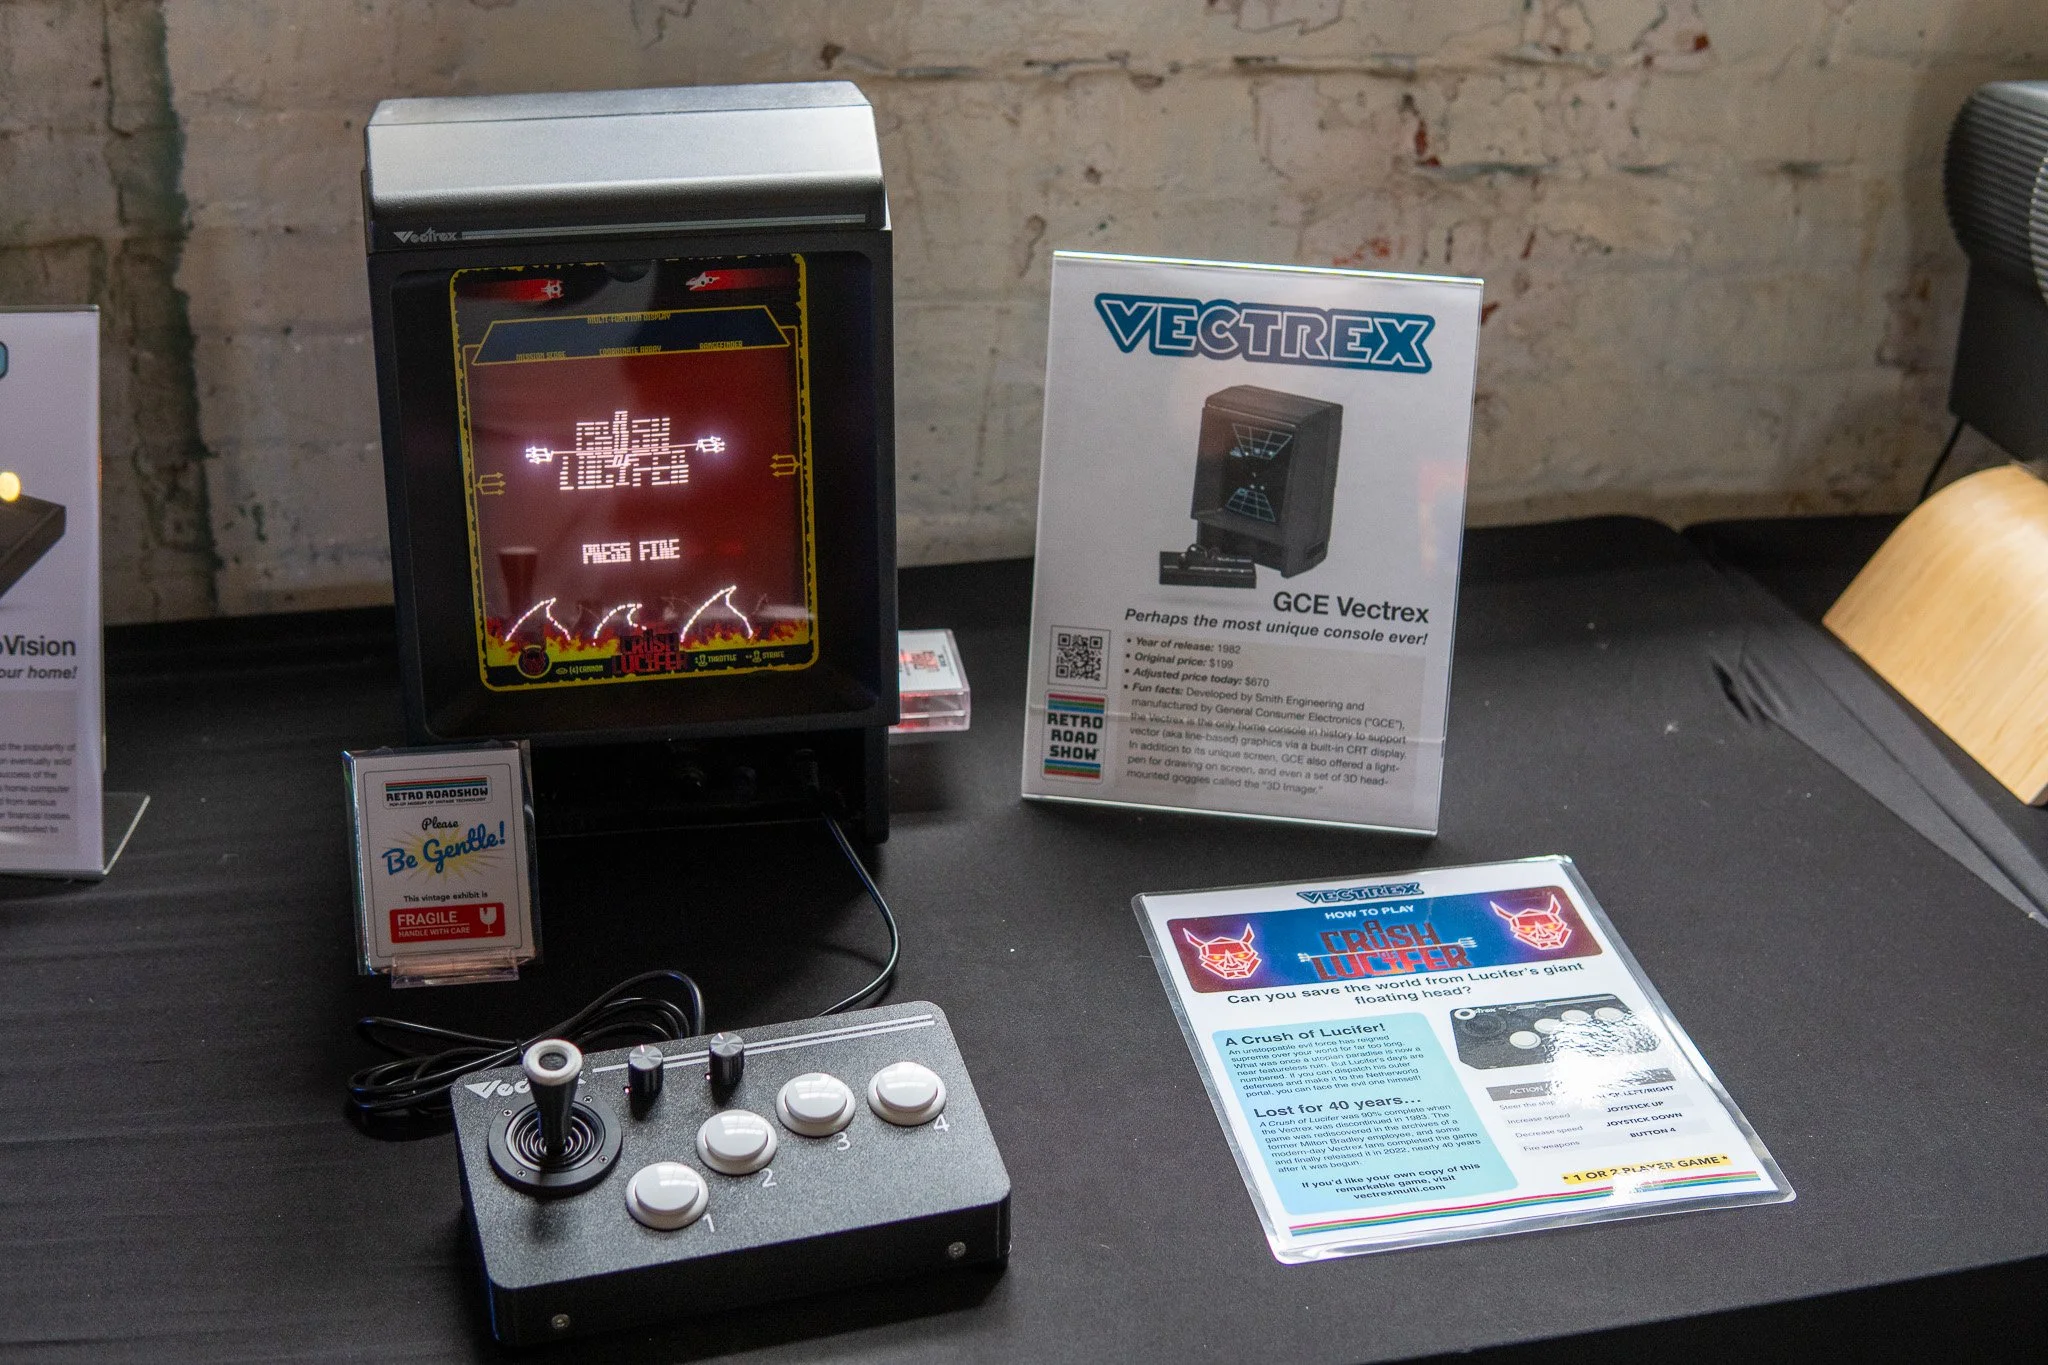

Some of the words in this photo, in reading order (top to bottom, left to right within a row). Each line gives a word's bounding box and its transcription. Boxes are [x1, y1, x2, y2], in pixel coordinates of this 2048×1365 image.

[393, 227, 457, 243] Vectrex
[1094, 293, 1436, 374] VECTREX
[583, 542, 631, 564] PRESS
[639, 539, 680, 561] FIRE
[1273, 592, 1329, 615] GCE
[1336, 597, 1429, 624] Vectrex
[1125, 608, 1188, 627] Perhaps
[1194, 613, 1217, 628] the
[1221, 617, 1263, 632] most
[1265, 620, 1319, 638] unique
[1324, 626, 1384, 643] console
[1389, 632, 1428, 646] ever!
[0, 635, 76, 656] Vision
[1135, 636, 1158, 647] Year
[1161, 639, 1170, 648] of
[1174, 640, 1213, 652] release:
[1218, 644, 1240, 654] 1982
[1134, 652, 1174, 665] Original
[1177, 656, 1205, 667] price:
[1209, 658, 1233, 669] $199
[27, 666, 78, 679] home!
[1133, 666, 1178, 680] Adjusted
[1181, 671, 1207, 682] price
[1211, 673, 1241, 686] today:
[1245, 676, 1268, 687] $670
[1132, 682, 1151, 692] Fun
[1155, 684, 1182, 695] facts:
[1186, 687, 1237, 701] Developed
[1240, 692, 1251, 702] by
[1255, 693, 1282, 703] Smith
[1285, 695, 1343, 711] Engineering
[1346, 701, 1364, 710] and
[1048, 712, 1103, 728] RETRO
[1131, 697, 1197, 711] manufactured
[1200, 703, 1211, 714] by
[1215, 704, 1251, 715] General
[1255, 708, 1304, 720] Consumer
[1309, 713, 1361, 725] Electronics
[1051, 729, 1097, 744] ROAD
[1130, 727, 1158, 737] vector
[1162, 729, 1182, 739] (aka
[1241, 736, 1282, 748] graphics
[1285, 740, 1298, 748] via
[1310, 742, 1343, 752] built-in
[1346, 745, 1367, 755] CRT
[1050, 745, 1096, 760] SHOW
[386, 792, 423, 801] RETRO
[426, 788, 488, 799] ROADSHOW
[422, 816, 459, 830] Please
[382, 847, 419, 875] Be
[423, 821, 506, 873] Gentle!
[420, 894, 451, 902] vintage
[1297, 882, 1424, 904] VECTREX
[397, 911, 458, 926] FRAGILE
[1325, 909, 1356, 920] HOW
[1359, 908, 1378, 916] TO
[1382, 905, 1414, 915] PLAY
[399, 928, 428, 937] HANDLE
[430, 928, 449, 936] WITH
[451, 926, 470, 935] CARE
[1320, 922, 1442, 954] CRUSH
[1311, 945, 1473, 981] LUCIFER
[1227, 994, 1260, 1004] Can
[1265, 991, 1297, 1002] you
[1302, 987, 1340, 997] save
[1344, 984, 1371, 993] the
[1375, 979, 1421, 990] world
[1425, 973, 1465, 985] from
[1469, 968, 1539, 981] Lucifer's
[1544, 962, 1585, 976] giant
[1355, 990, 1418, 1005] floating
[1423, 985, 1472, 998] head?
[1226, 1038, 1238, 1047] A
[1241, 1032, 1293, 1045] Crush
[1298, 1030, 1315, 1040] of
[1320, 1023, 1386, 1037] Lucifer!
[1509, 1086, 1544, 1095] ACTION
[1624, 1085, 1674, 1096] LEFT/RIGHT
[1254, 1105, 1295, 1118] Lost
[1300, 1104, 1323, 1114] for
[1329, 1100, 1349, 1111] 40
[1354, 1096, 1421, 1110] years...
[1499, 1102, 1522, 1111] Steer
[1524, 1101, 1536, 1109] the
[1538, 1099, 1556, 1108] ship
[1607, 1103, 1650, 1112] JOYSTICK
[932, 1115, 951, 1134] 4
[1269, 1118, 1296, 1127] Crush
[1309, 1114, 1340, 1123] Lucifer
[1385, 1107, 1424, 1117] complete
[1507, 1115, 1542, 1125] Increase
[1544, 1112, 1571, 1122] speed
[1607, 1117, 1650, 1127] JOYSTICK
[1651, 1112, 1682, 1121] DOWN
[1515, 1128, 1555, 1139] Decrease
[1556, 1125, 1583, 1135] speed
[1630, 1128, 1668, 1138] BUTTON
[835, 1132, 852, 1151] 3
[1542, 1140, 1580, 1150] weapons
[1312, 1179, 1342, 1189] you'd
[1345, 1177, 1363, 1185] like
[1367, 1174, 1390, 1183] your
[1419, 1168, 1444, 1177] copy
[1461, 1163, 1480, 1171] this
[1586, 1170, 1607, 1180] OR
[1622, 1162, 1675, 1174] PLAYER
[1678, 1156, 1721, 1167] GAME
[760, 1167, 778, 1188] 2
[1336, 1182, 1396, 1194] remarkable
[1398, 1178, 1431, 1188] game,
[1353, 1184, 1446, 1200] vectrexmulti.com
[701, 1212, 716, 1233] 1
